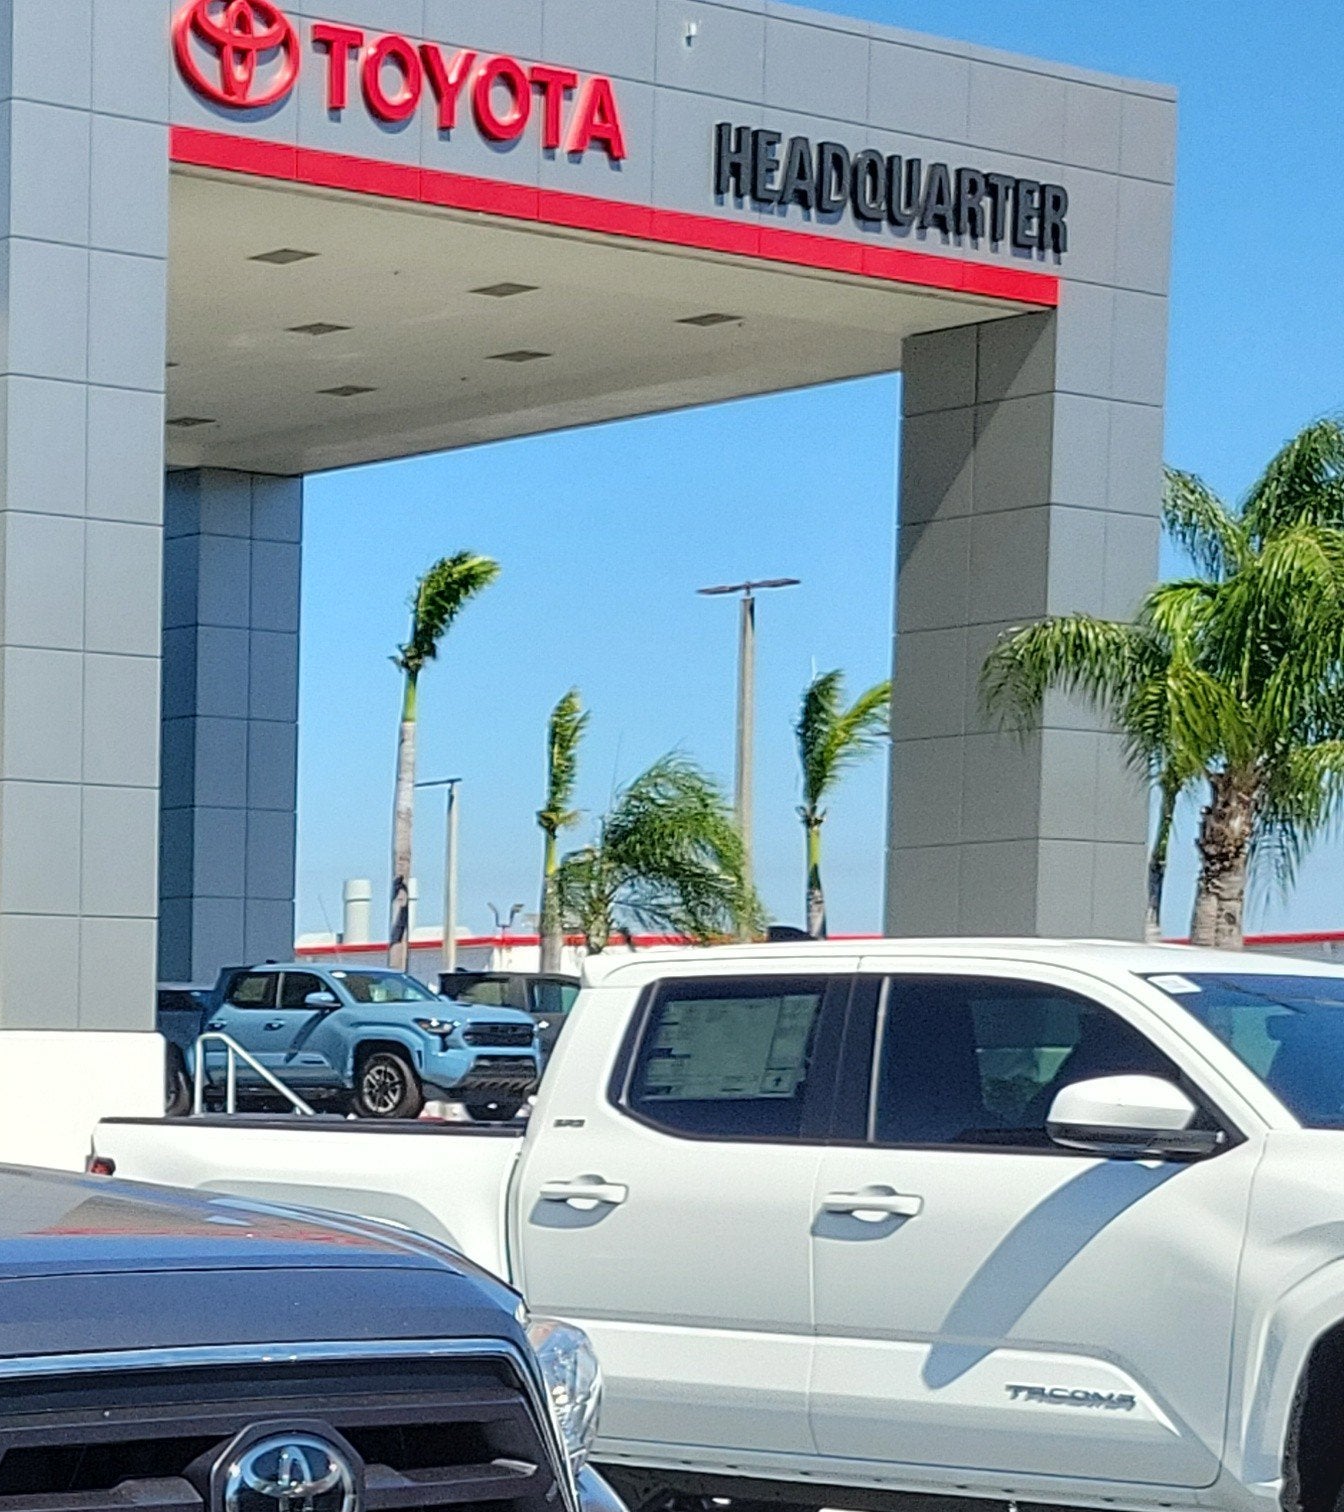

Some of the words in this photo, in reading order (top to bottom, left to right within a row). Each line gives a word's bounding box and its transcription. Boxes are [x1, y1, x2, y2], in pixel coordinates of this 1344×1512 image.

[311, 23, 628, 160] TOYOTA
[714, 122, 1069, 253] HEADQUARTER
[1004, 1384, 1137, 1410] TACOMA
